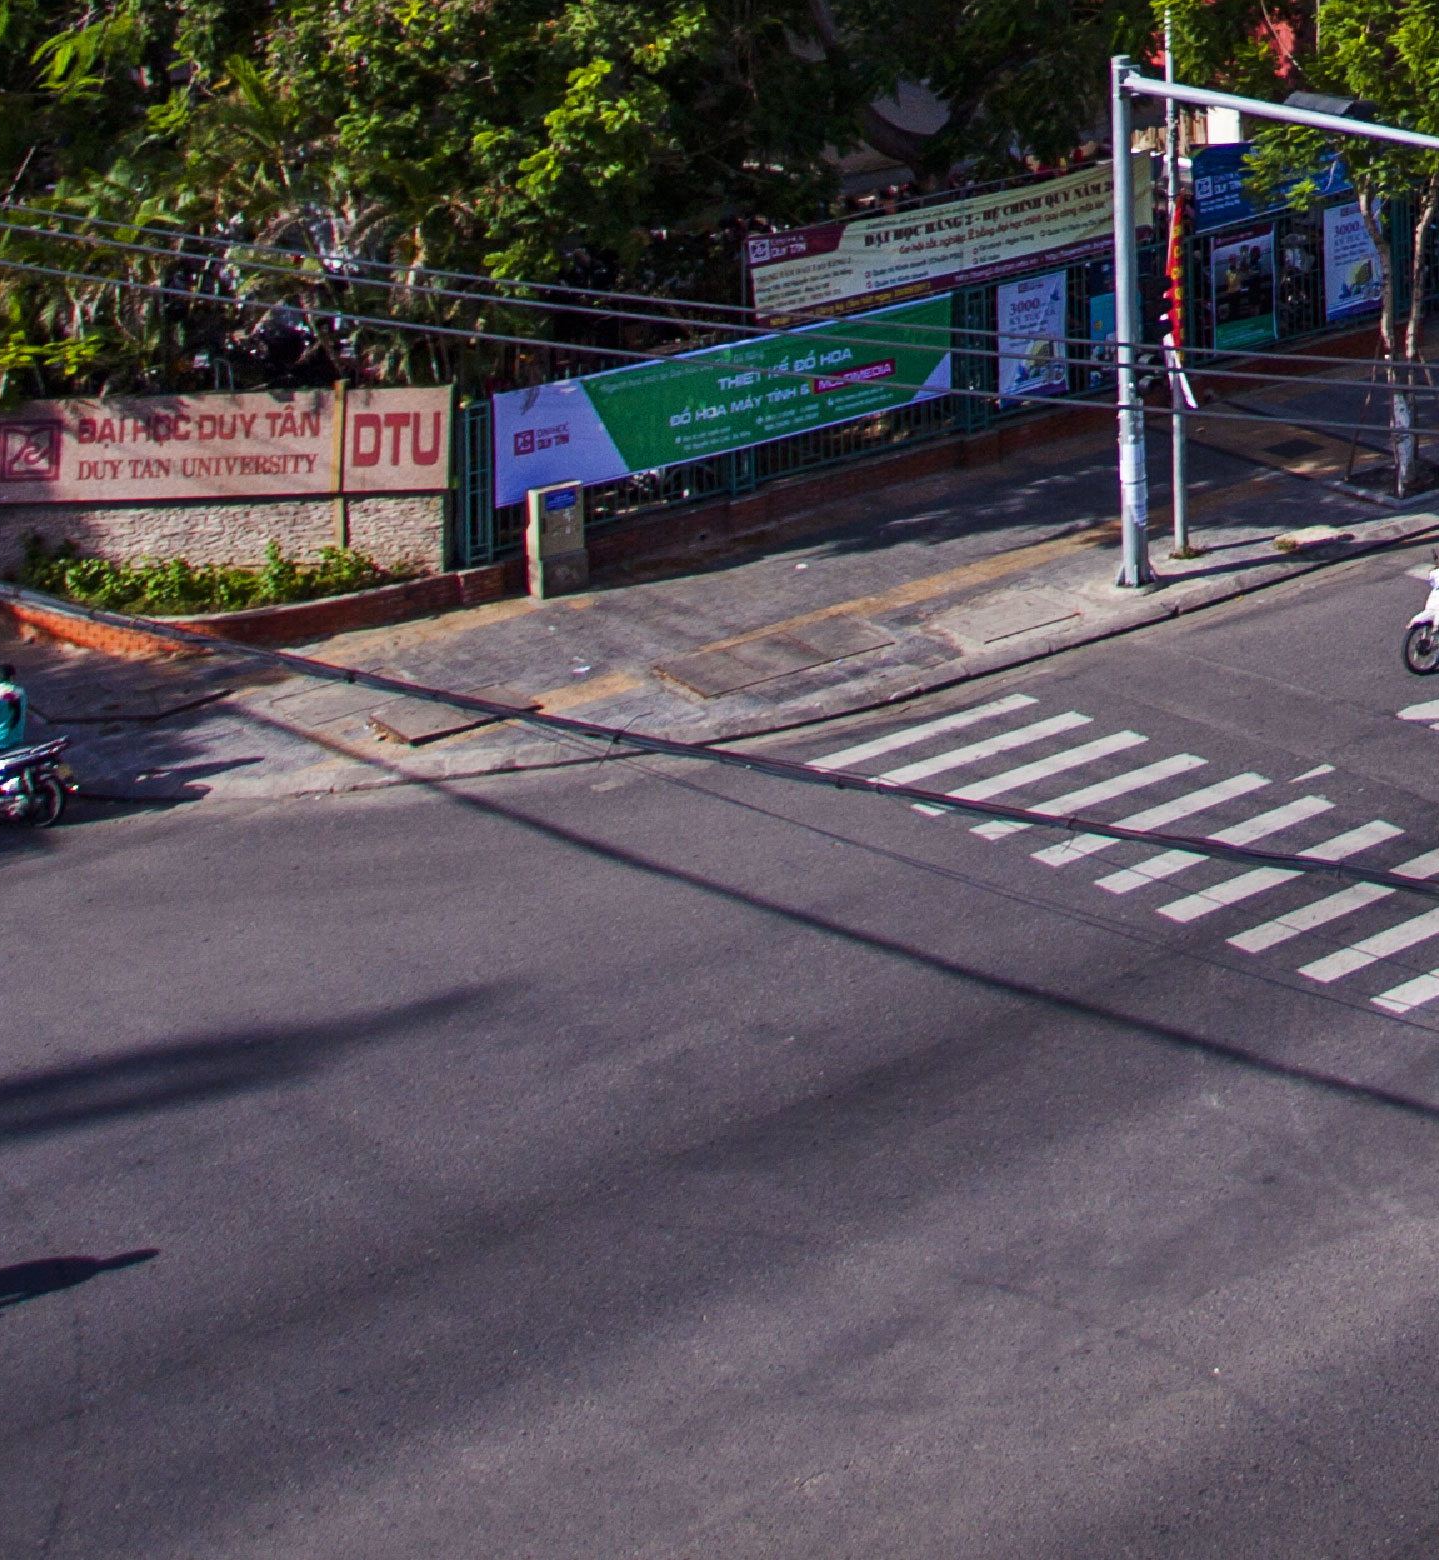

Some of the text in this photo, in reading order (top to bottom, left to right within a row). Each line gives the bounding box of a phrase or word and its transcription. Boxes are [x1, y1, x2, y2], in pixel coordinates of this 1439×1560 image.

[78, 404, 320, 449] ĐẠI HỌC DUY TÂN
[352, 410, 441, 468] DTU
[77, 453, 319, 481] DUY TAN UNIVERSITY
